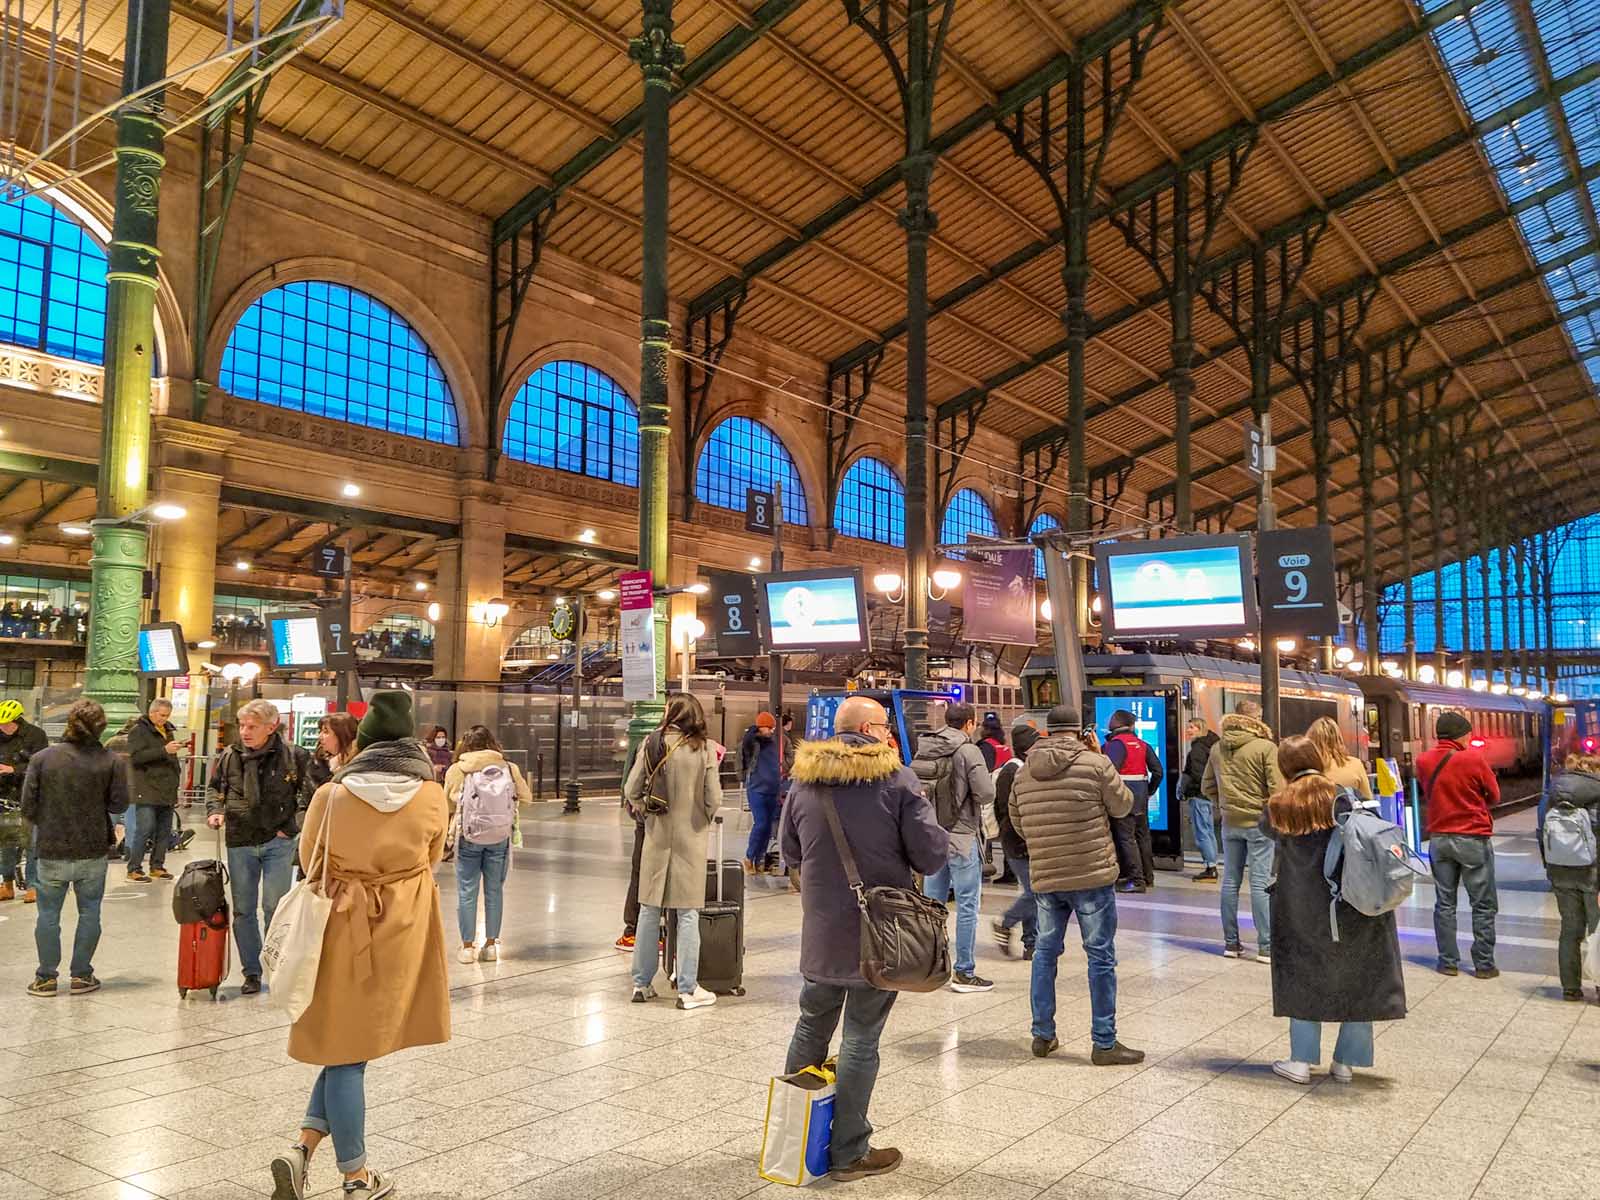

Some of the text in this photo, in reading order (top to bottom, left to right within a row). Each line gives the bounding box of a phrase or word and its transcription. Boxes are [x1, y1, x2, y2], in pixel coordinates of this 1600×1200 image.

[1252, 444, 1259, 467] 9
[756, 505, 765, 524] 8
[323, 556, 334, 570] 7
[1282, 557, 1306, 566] Voie
[1285, 570, 1307, 602] 9
[728, 606, 742, 631] 8
[332, 633, 341, 651] 7
